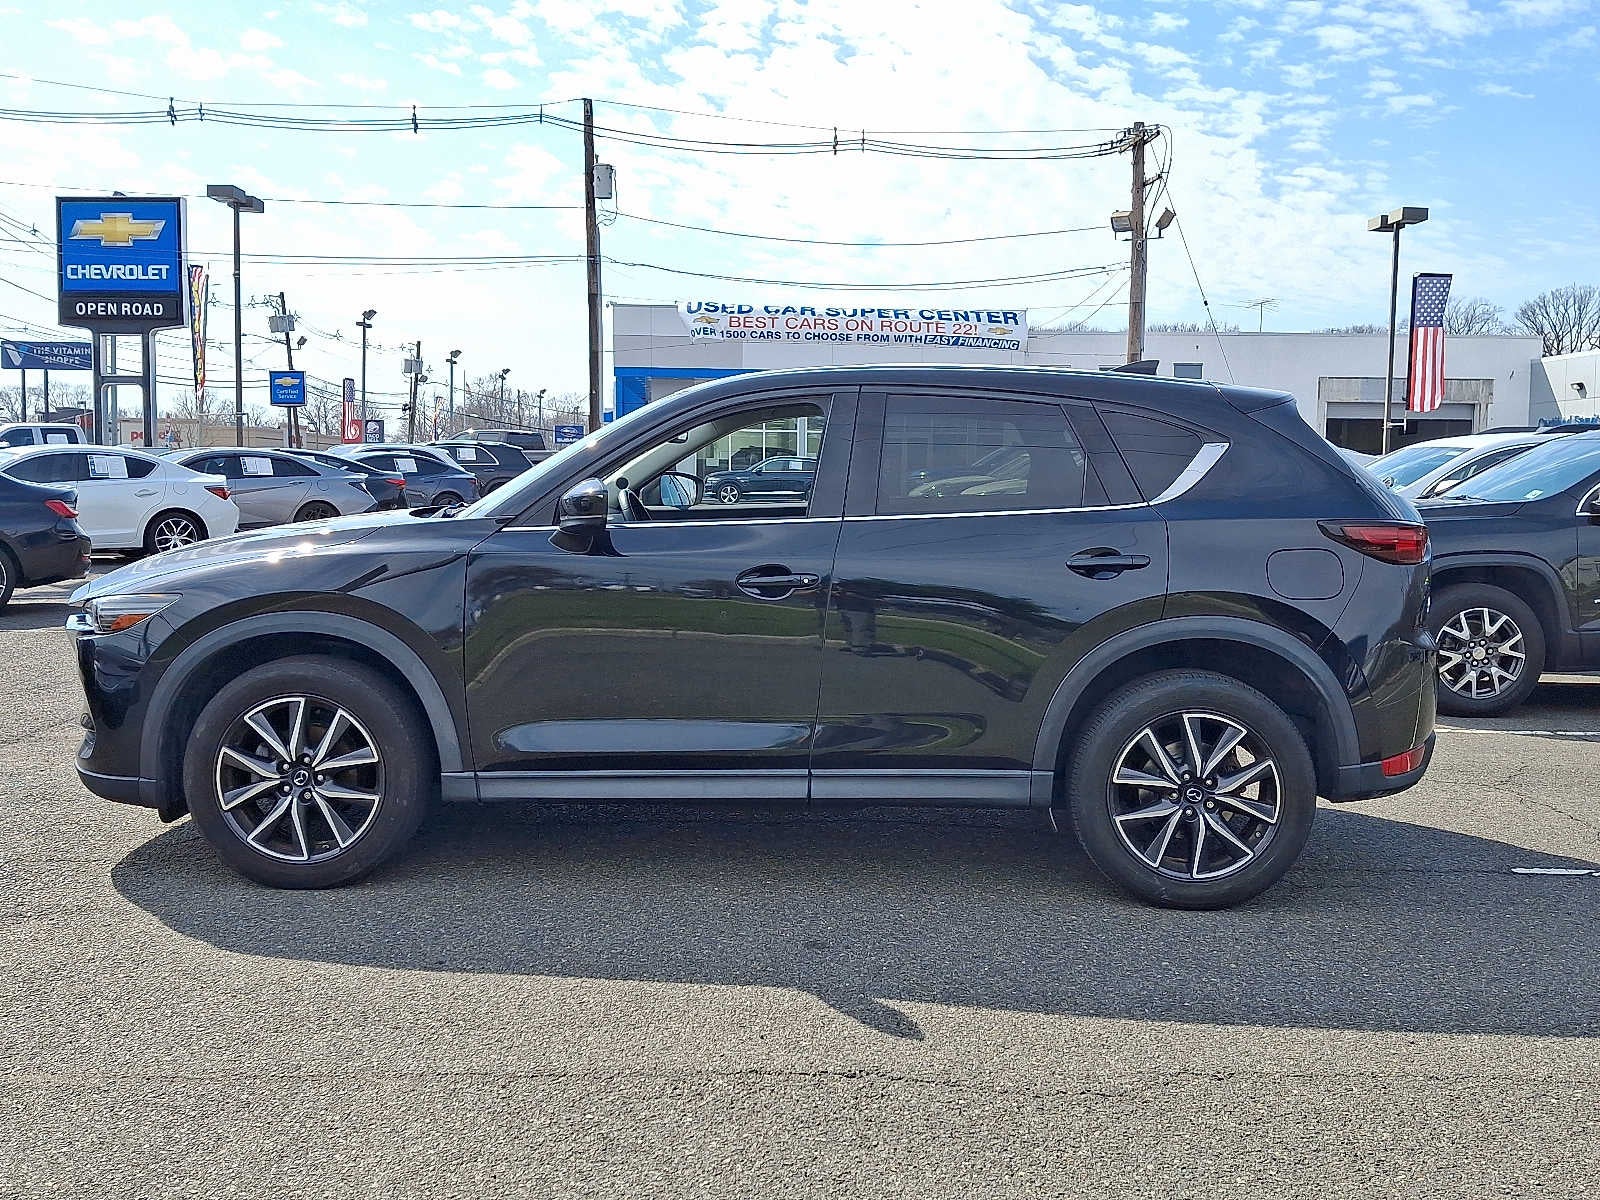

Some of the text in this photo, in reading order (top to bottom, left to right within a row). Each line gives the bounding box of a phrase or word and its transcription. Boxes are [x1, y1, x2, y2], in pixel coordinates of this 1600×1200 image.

[66, 264, 170, 280] CHEVROLET
[75, 302, 164, 316] OPEN ROAD
[686, 301, 1020, 326] USED CAR SUPER CENTER
[728, 315, 978, 336] BEST CARS ON ROUTE 22!
[690, 326, 1020, 350] OVER 1500 CARS TO CHOOSE FROM WITH EASY FINANCING
[52, 347, 91, 355] VITAMIN
